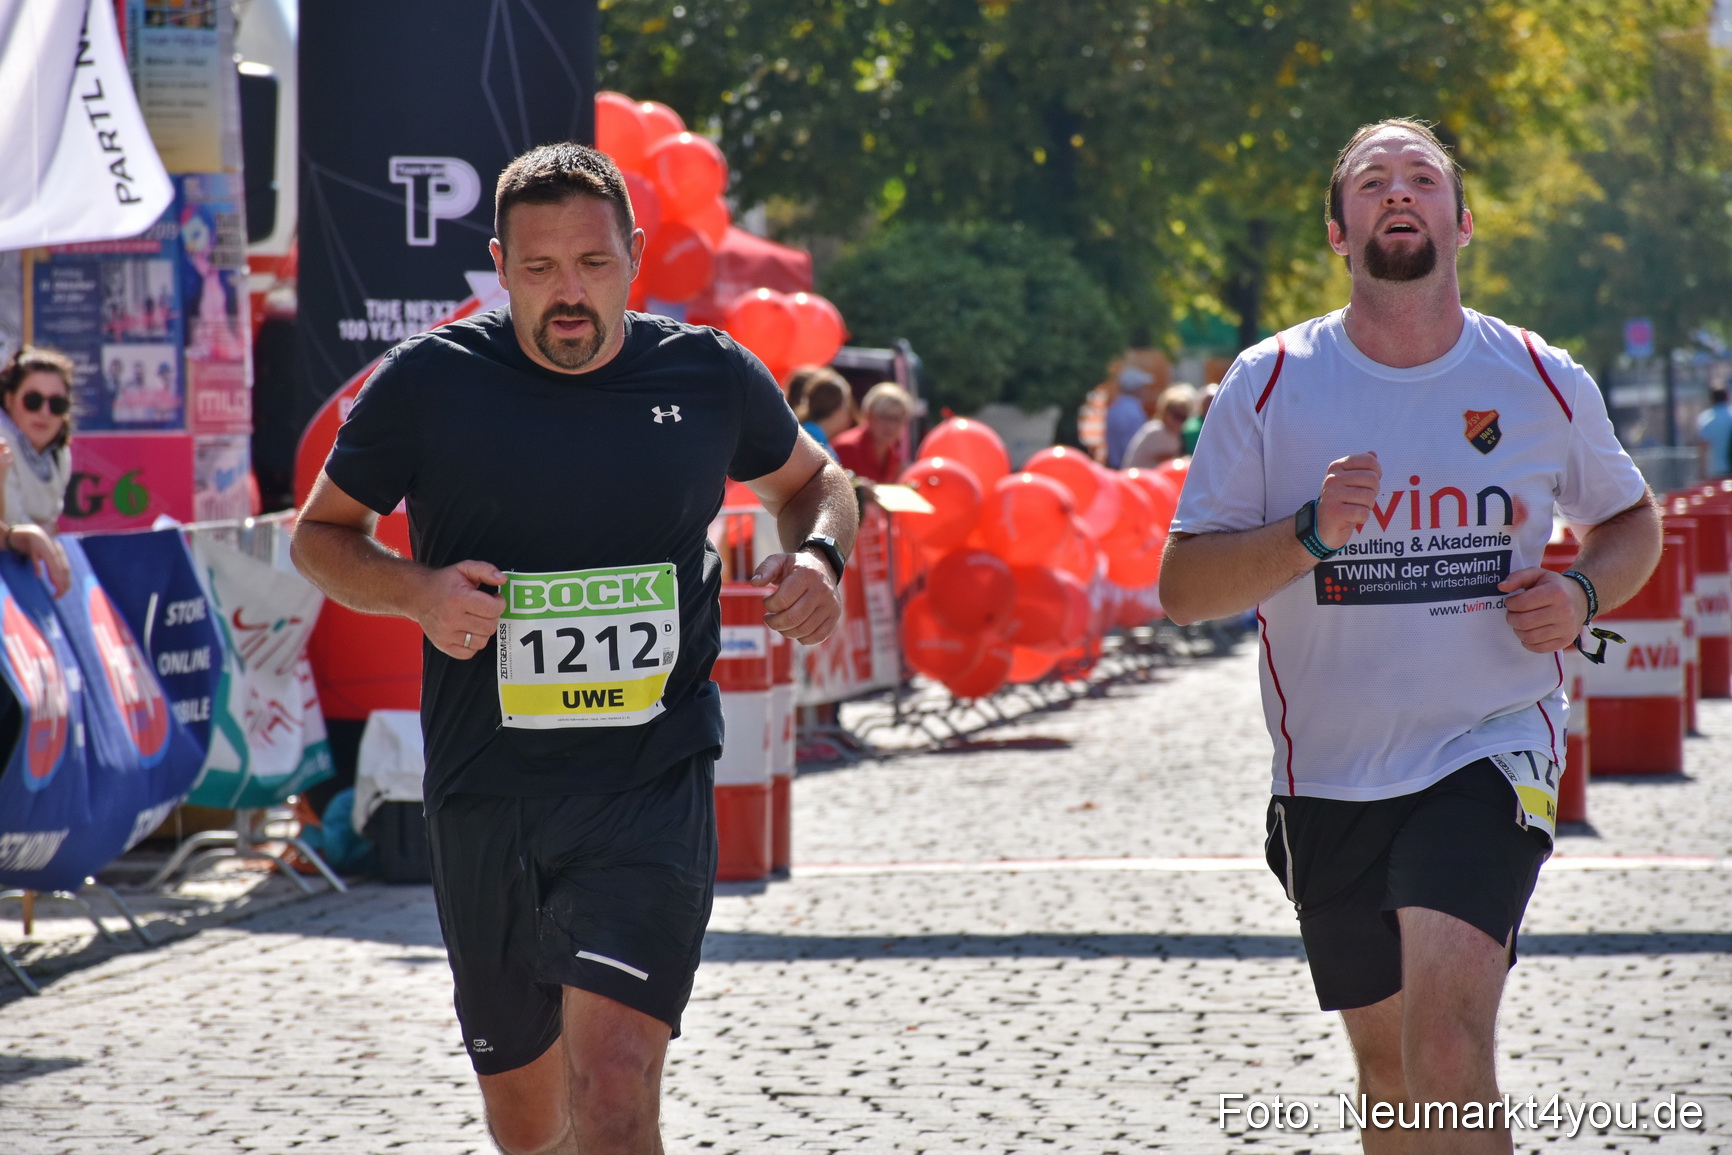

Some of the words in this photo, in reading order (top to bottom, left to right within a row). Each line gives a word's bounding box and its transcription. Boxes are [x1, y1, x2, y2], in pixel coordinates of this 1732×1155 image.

[82, 78, 142, 206] PARTL
[365, 299, 401, 320] THE
[338, 319, 368, 341] 100
[1352, 475, 1513, 534] winn
[1338, 538, 1404, 556] nsulting
[1411, 536, 1423, 551] &
[1427, 532, 1511, 551] Akademie
[1334, 563, 1396, 580] TWINN
[1401, 562, 1430, 578] der
[1434, 555, 1501, 576] Gewinn!
[510, 571, 663, 614] BOCK
[1359, 580, 1417, 594] persönlich
[1431, 573, 1500, 589] wirtschaftlich
[663, 624, 672, 633] D
[520, 622, 660, 674] 1212
[157, 646, 211, 676] ONLINE
[562, 688, 624, 709] UWE
